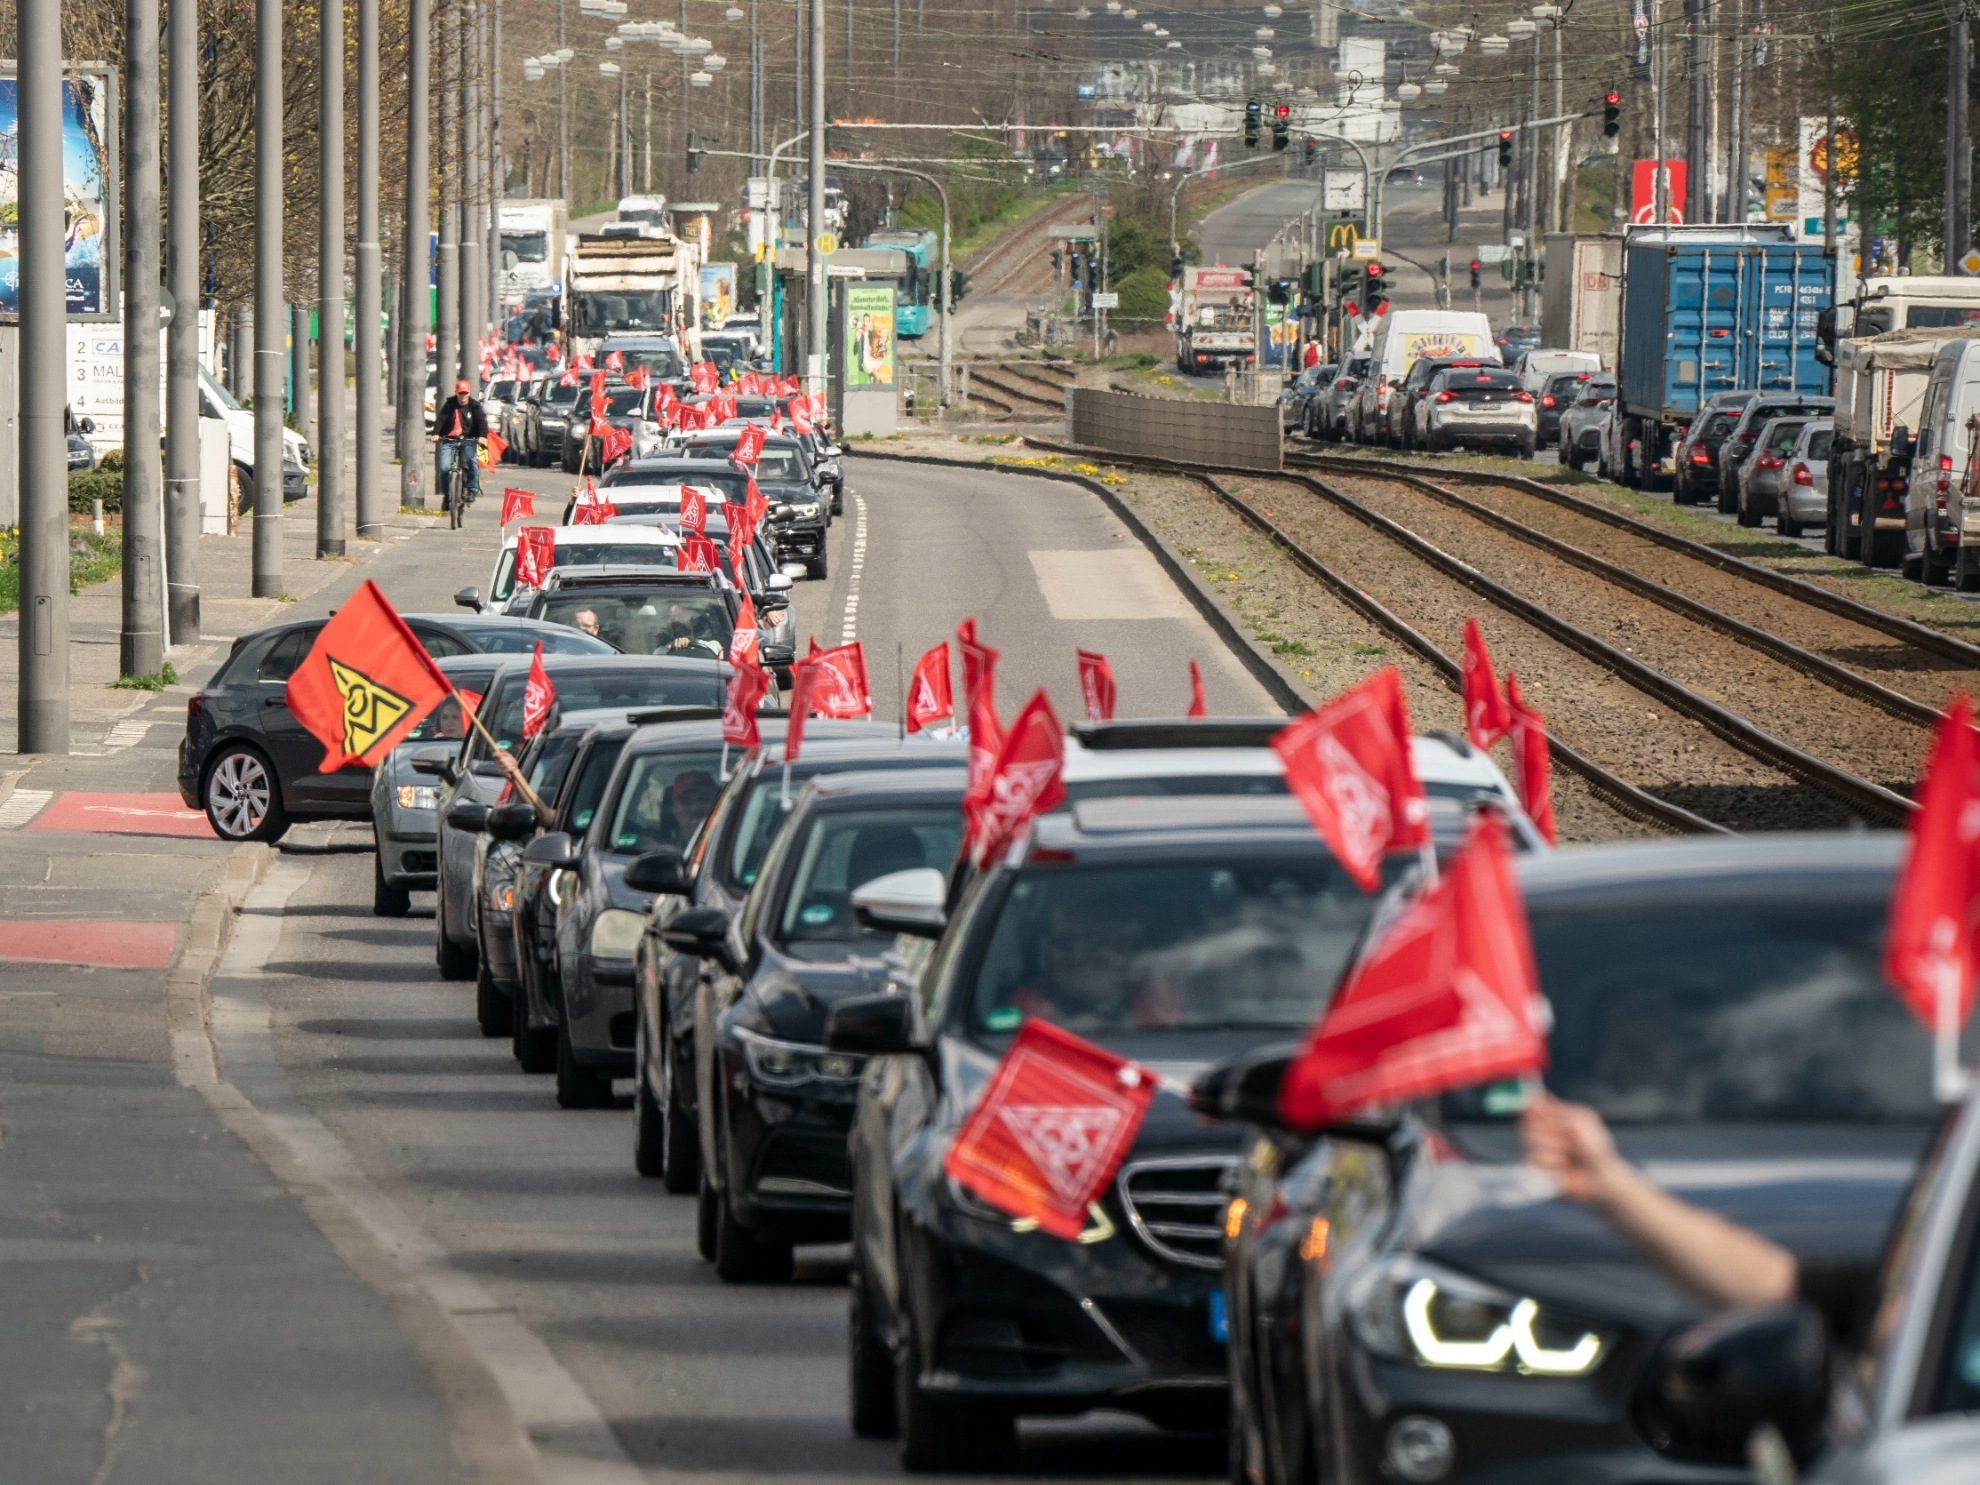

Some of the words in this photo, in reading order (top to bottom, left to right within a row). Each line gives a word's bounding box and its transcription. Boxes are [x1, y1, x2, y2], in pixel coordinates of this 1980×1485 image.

[1587, 275, 1607, 289] DB
[77, 341, 86, 354] 2
[77, 368, 86, 381] 3
[77, 395, 85, 407] 4
